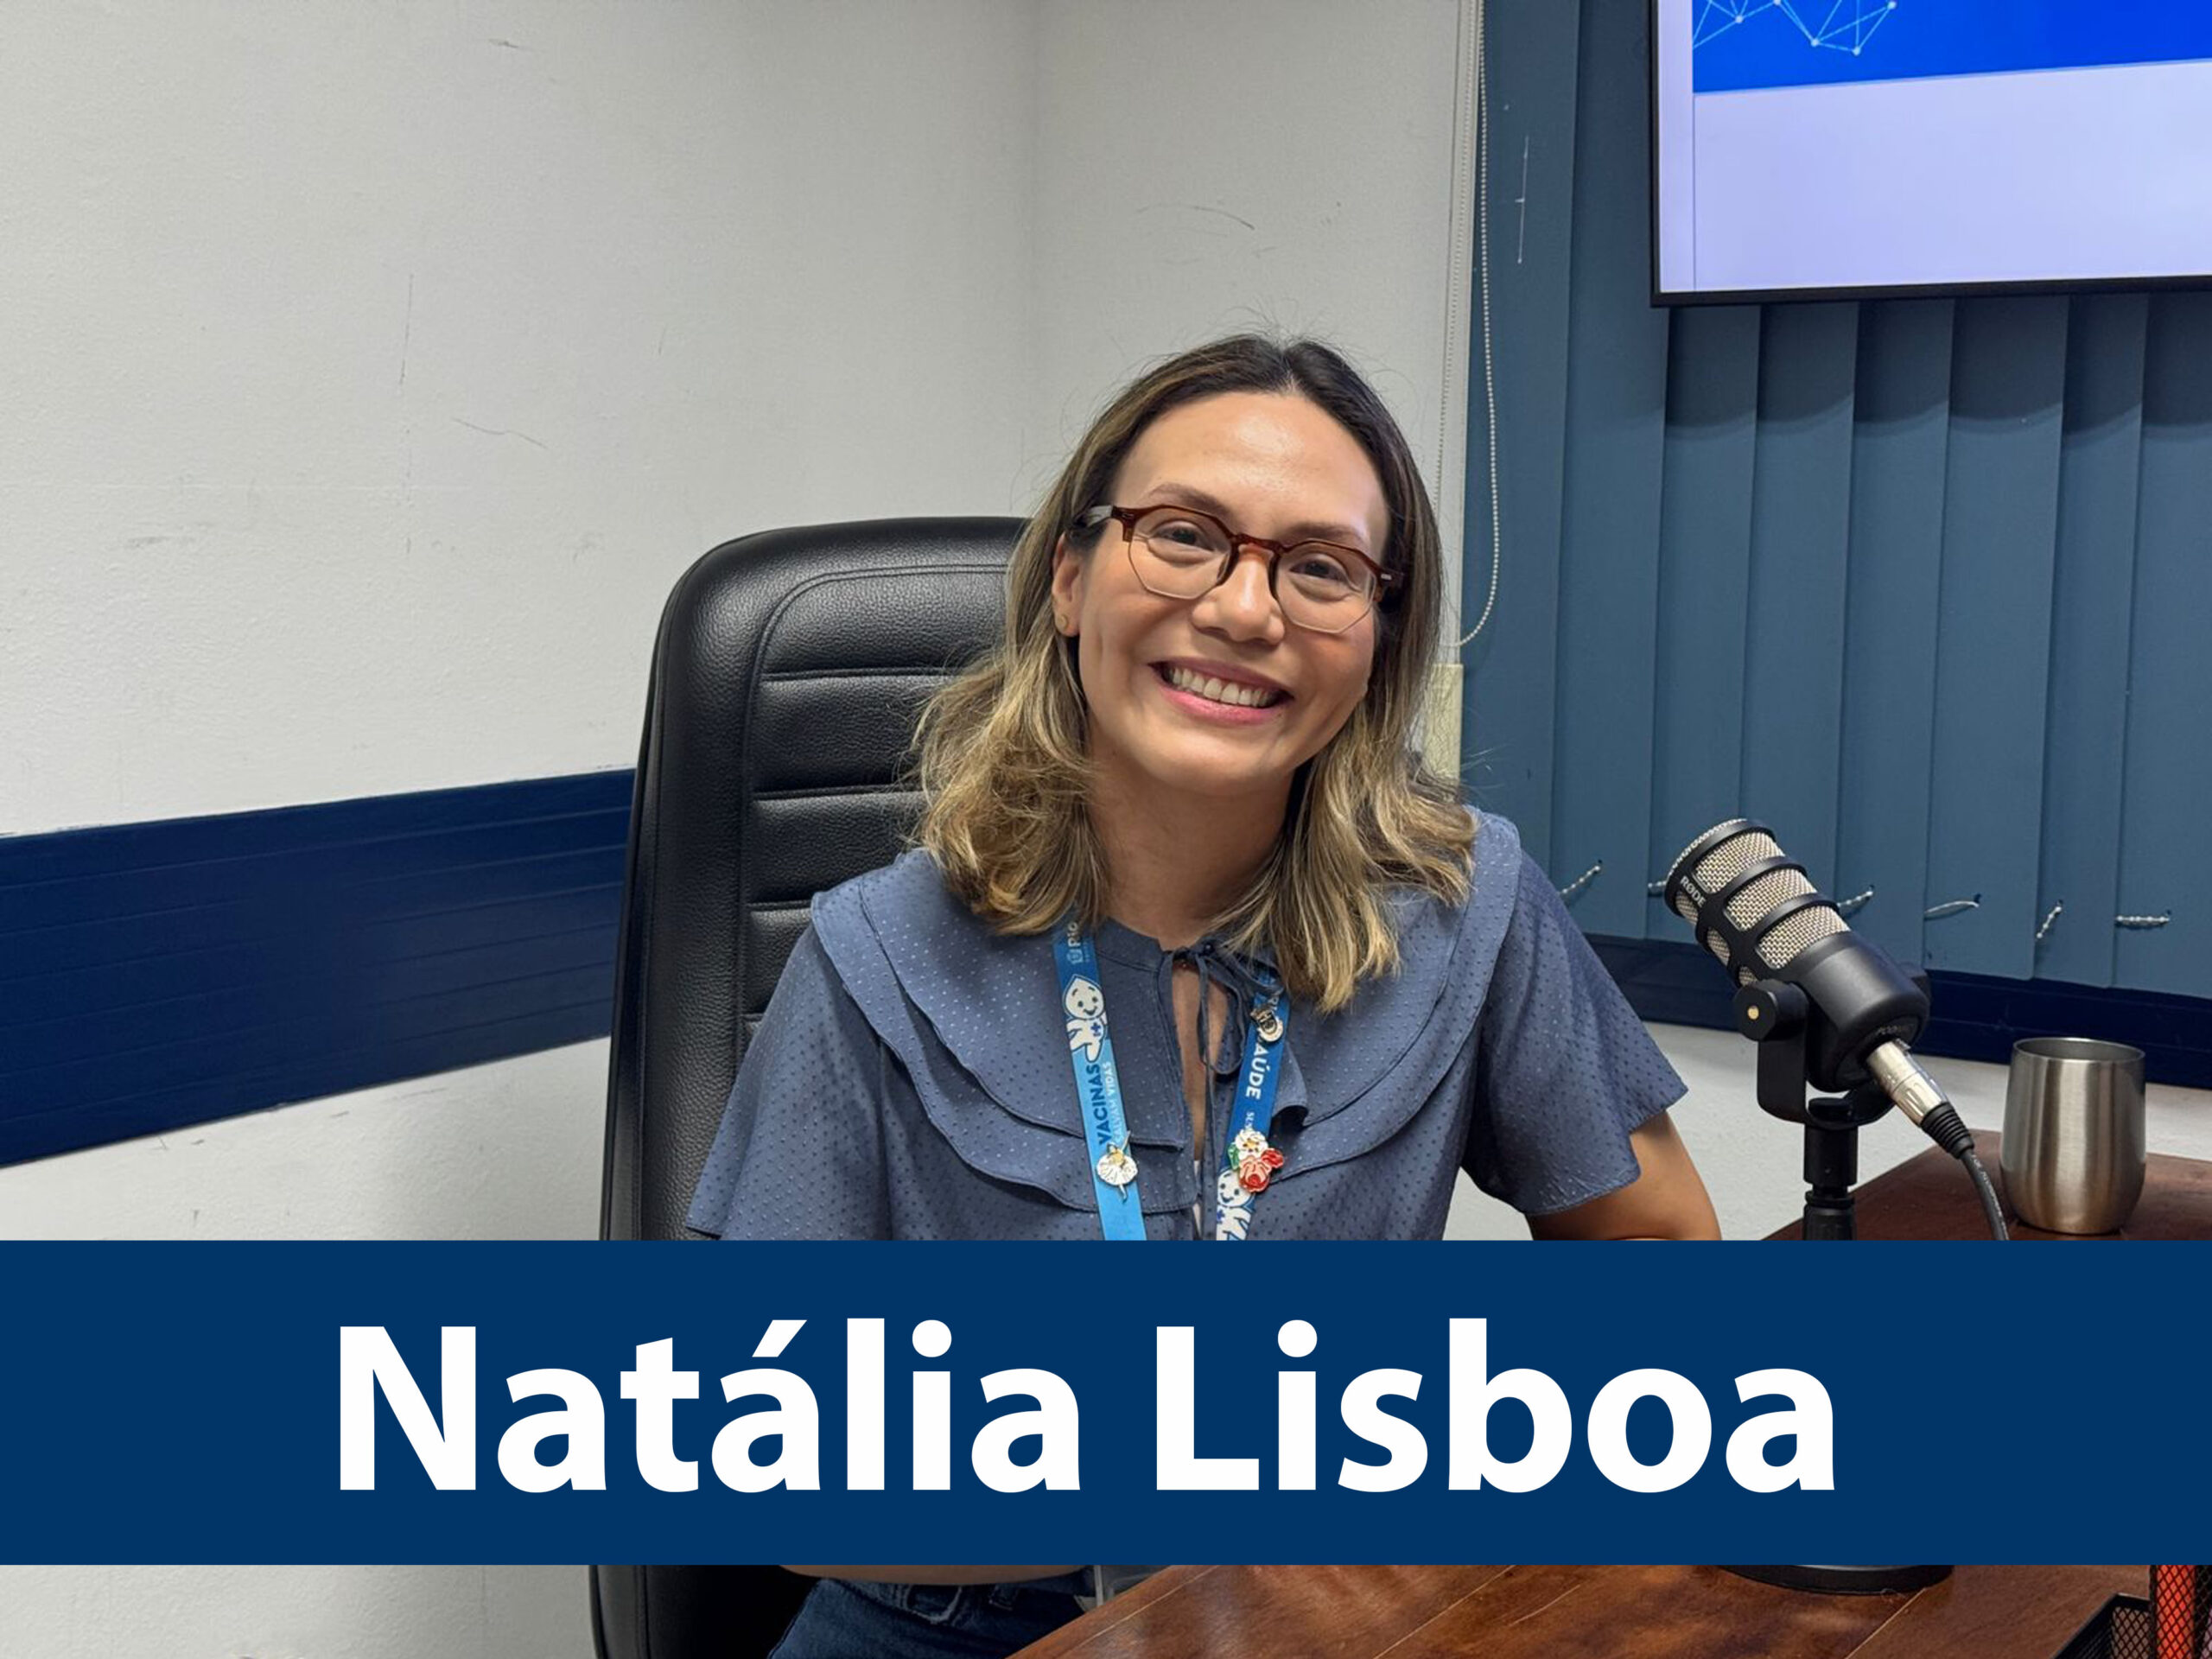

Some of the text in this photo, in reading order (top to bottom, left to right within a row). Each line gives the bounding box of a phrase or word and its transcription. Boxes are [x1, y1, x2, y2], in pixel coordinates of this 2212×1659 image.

[1103, 1061, 1115, 1096] VIDAS
[1245, 1037, 1270, 1100] AÚDE
[1086, 1064, 1112, 1145] VACINAS
